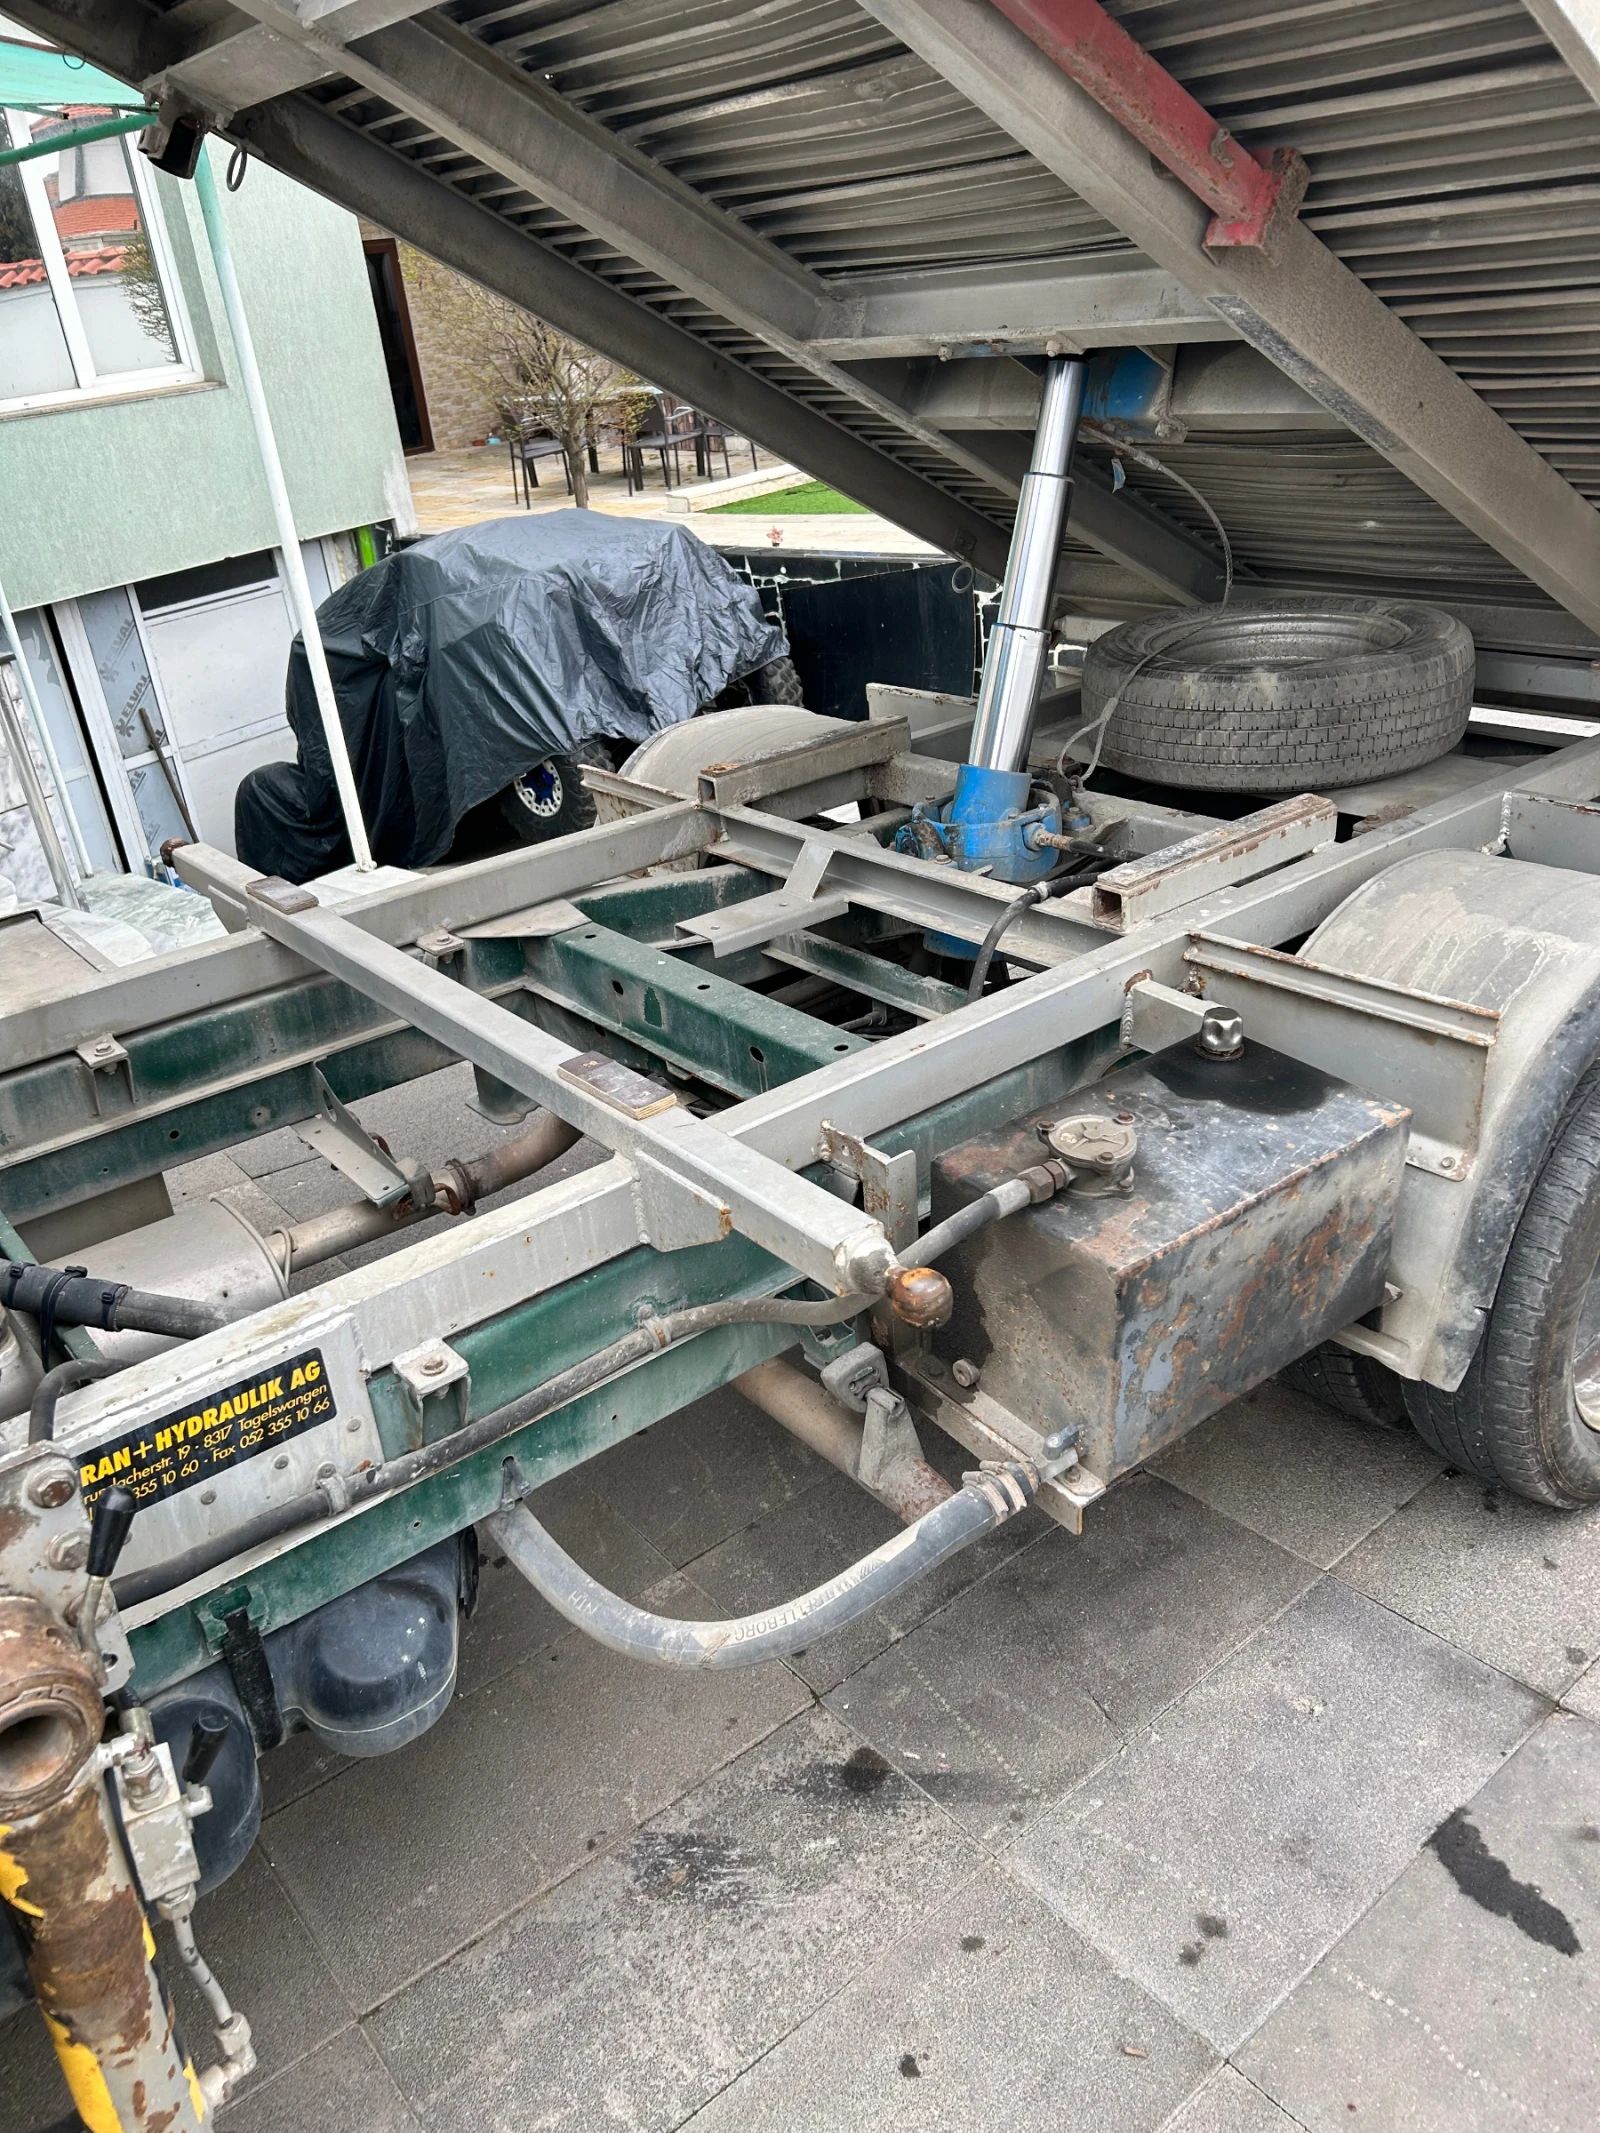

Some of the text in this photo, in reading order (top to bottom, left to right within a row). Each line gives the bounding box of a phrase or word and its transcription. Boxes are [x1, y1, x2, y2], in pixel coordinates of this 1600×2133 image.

[121, 675, 151, 717] ELVAL
[290, 1360, 321, 1391] AG
[162, 1471, 177, 1486] 10
[180, 1459, 199, 1477] 60
[212, 1445, 236, 1462] Fax
[240, 1429, 264, 1449] 052
[268, 1414, 292, 1436] 355
[296, 1407, 310, 1422] 10
[313, 1397, 330, 1414] 66
[177, 1444, 191, 1461] 19
[203, 1424, 233, 1448] 8317
[238, 1385, 327, 1431] Tagelswangen
